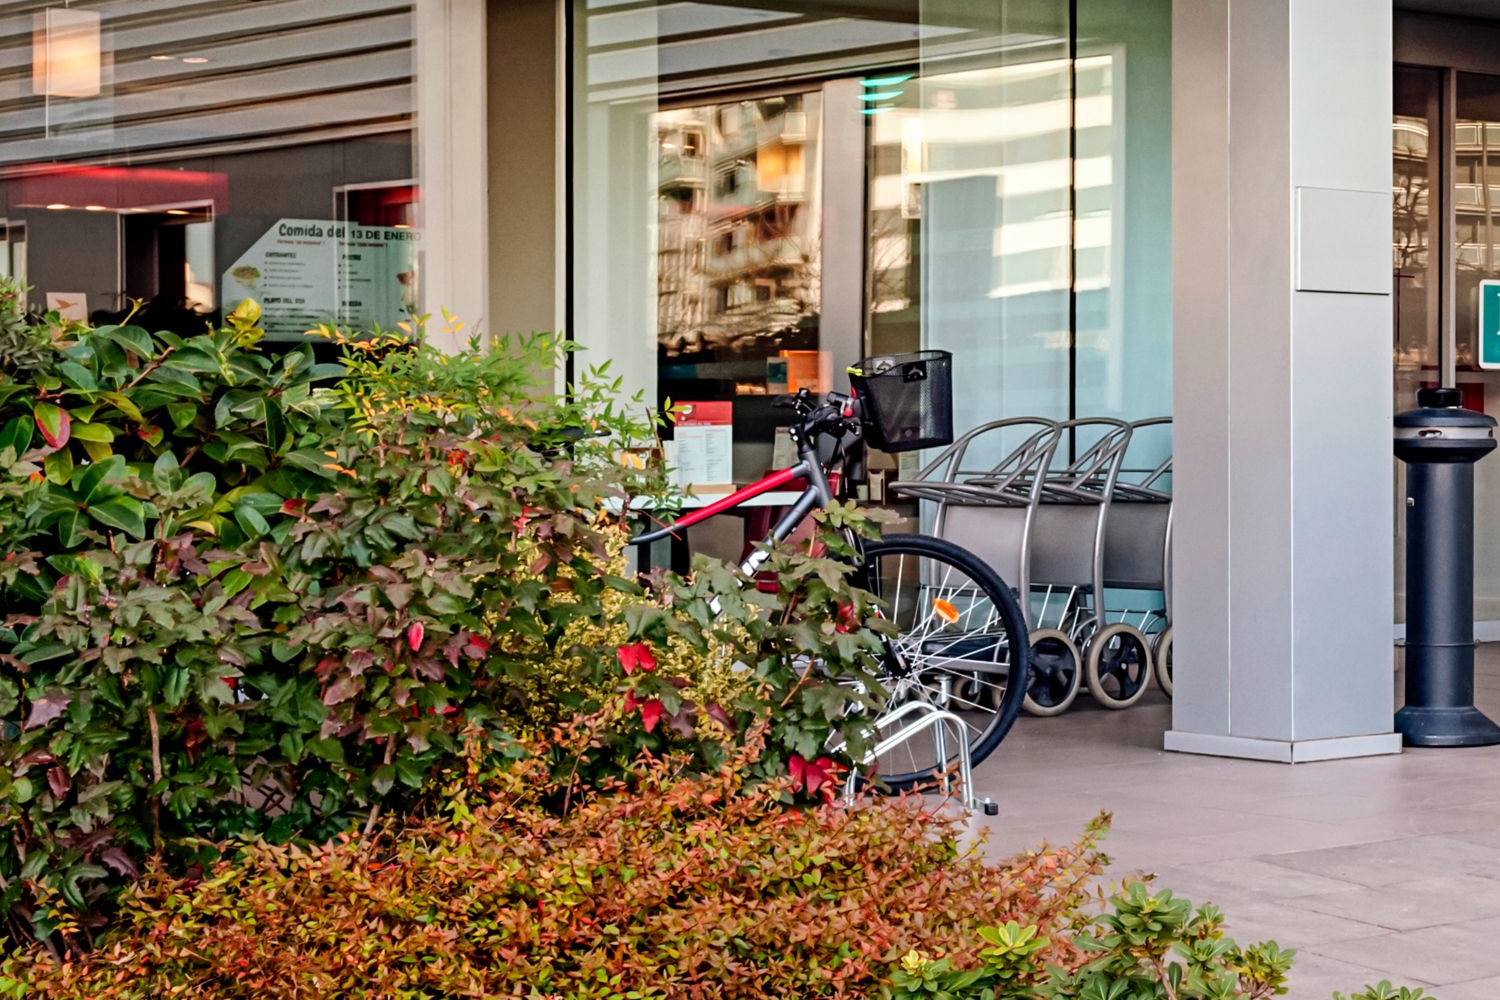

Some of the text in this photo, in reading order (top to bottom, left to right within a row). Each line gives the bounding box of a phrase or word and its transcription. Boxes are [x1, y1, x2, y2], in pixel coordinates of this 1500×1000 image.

[279, 223, 421, 241] Comida del 13 DE ENERO
